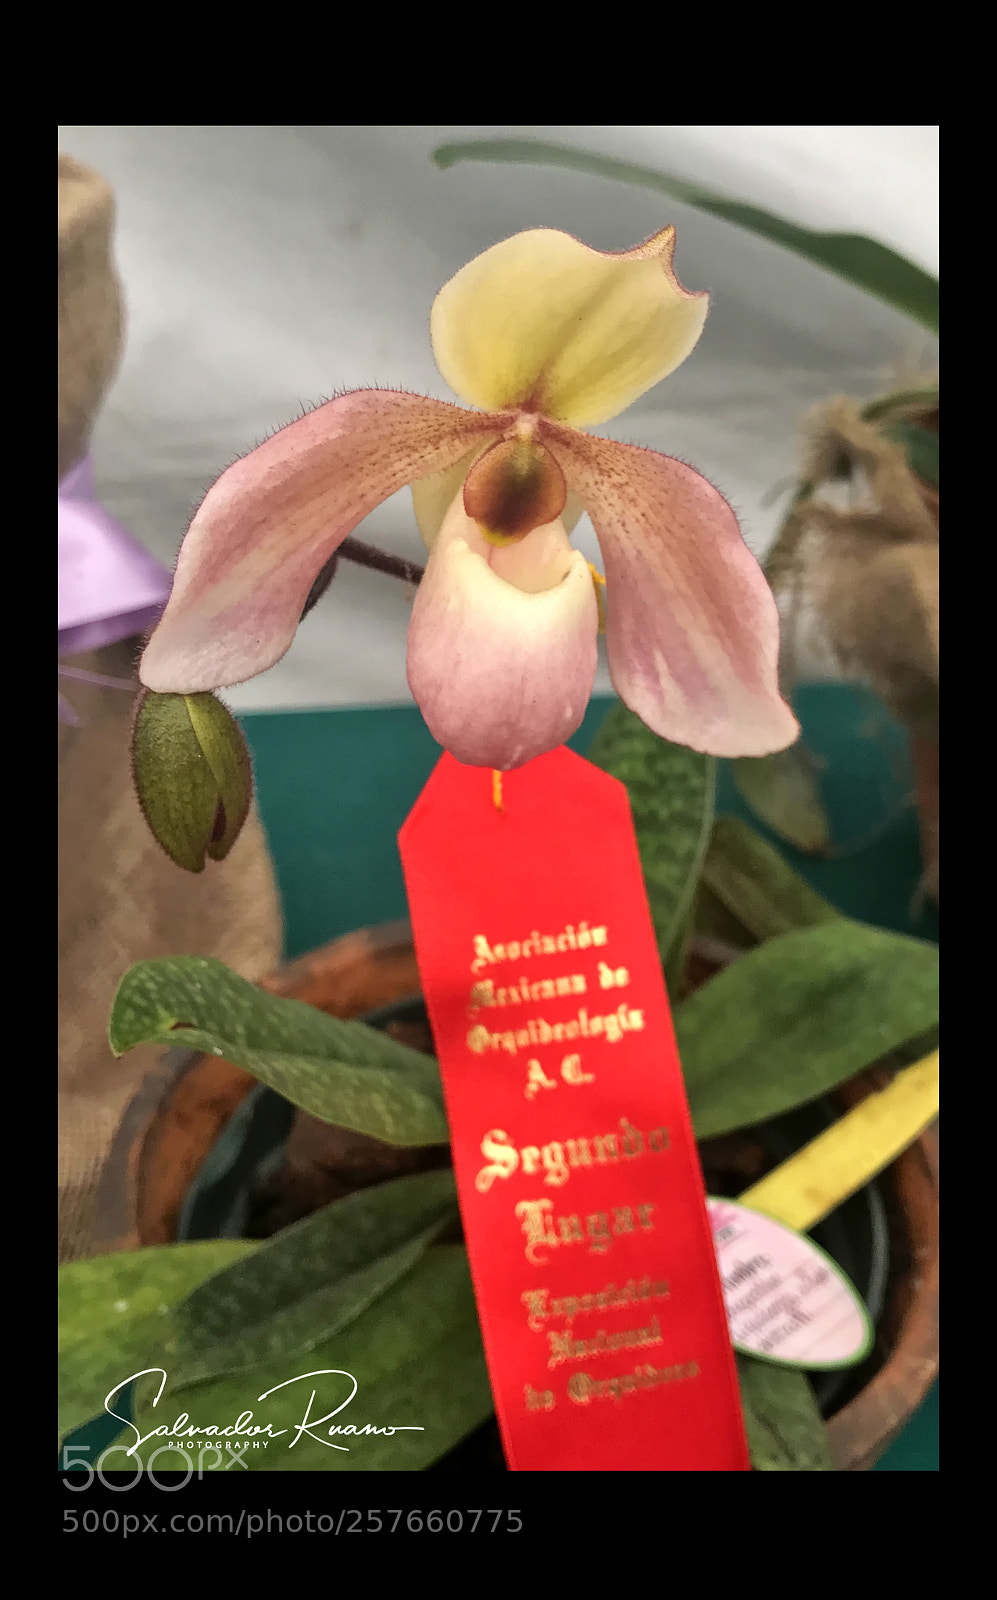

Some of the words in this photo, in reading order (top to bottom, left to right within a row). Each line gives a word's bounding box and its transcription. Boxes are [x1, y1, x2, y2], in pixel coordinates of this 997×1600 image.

[467, 974, 586, 1020] Mexicana
[597, 961, 630, 990] de
[475, 1117, 670, 1193] Segundo
[515, 1198, 654, 1265] Lugar
